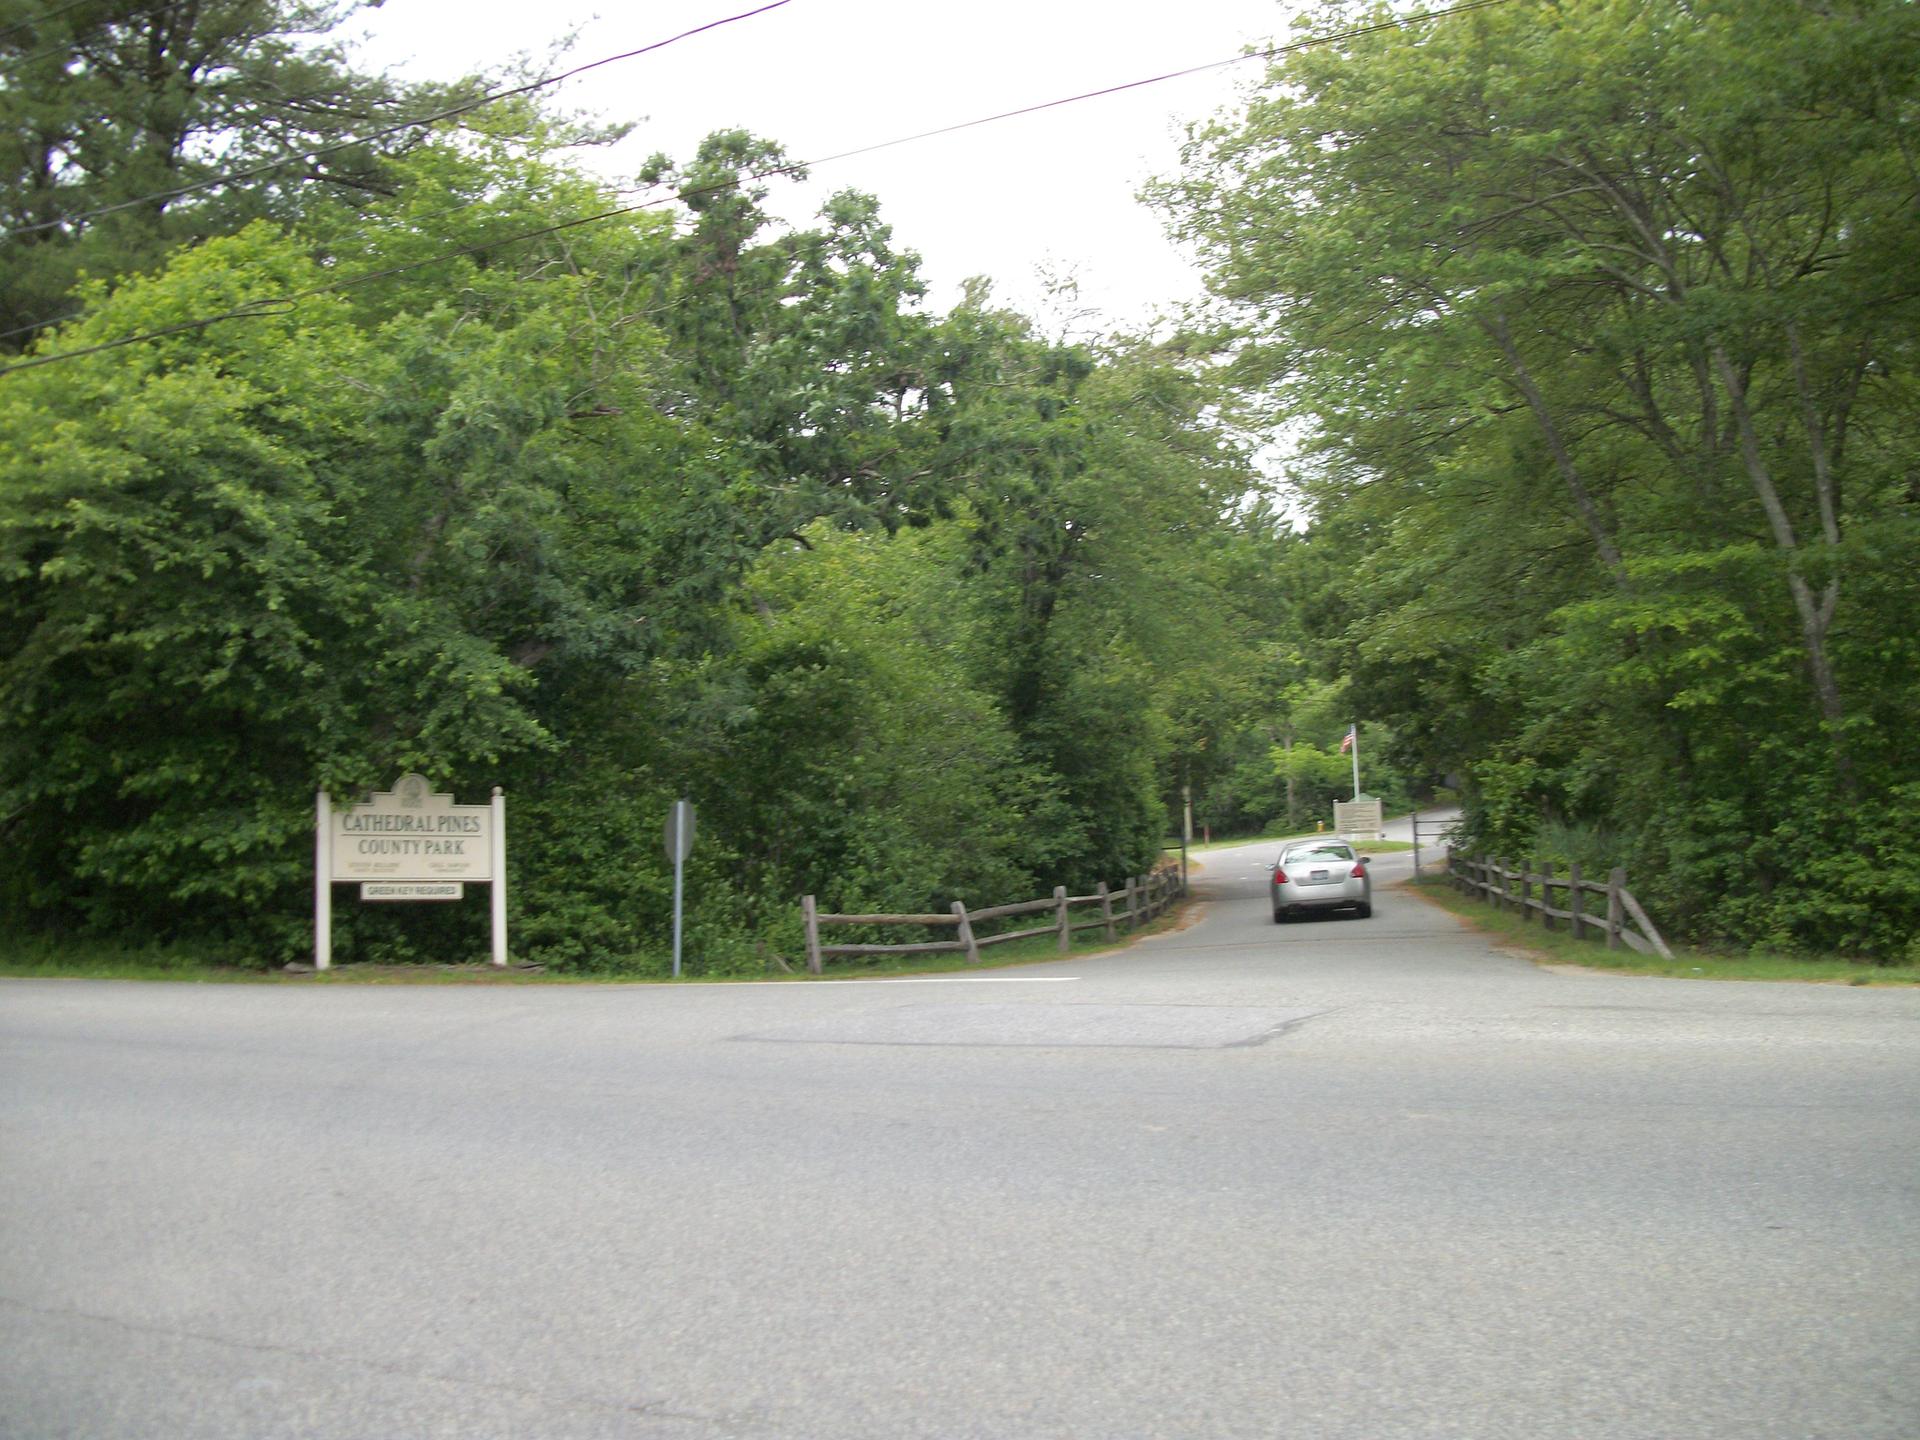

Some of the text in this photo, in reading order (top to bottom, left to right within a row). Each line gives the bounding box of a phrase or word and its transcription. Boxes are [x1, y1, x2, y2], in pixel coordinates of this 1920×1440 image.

[342, 814, 480, 833] CATHEDRAL PINES
[358, 839, 465, 855] COUNTY PARK
